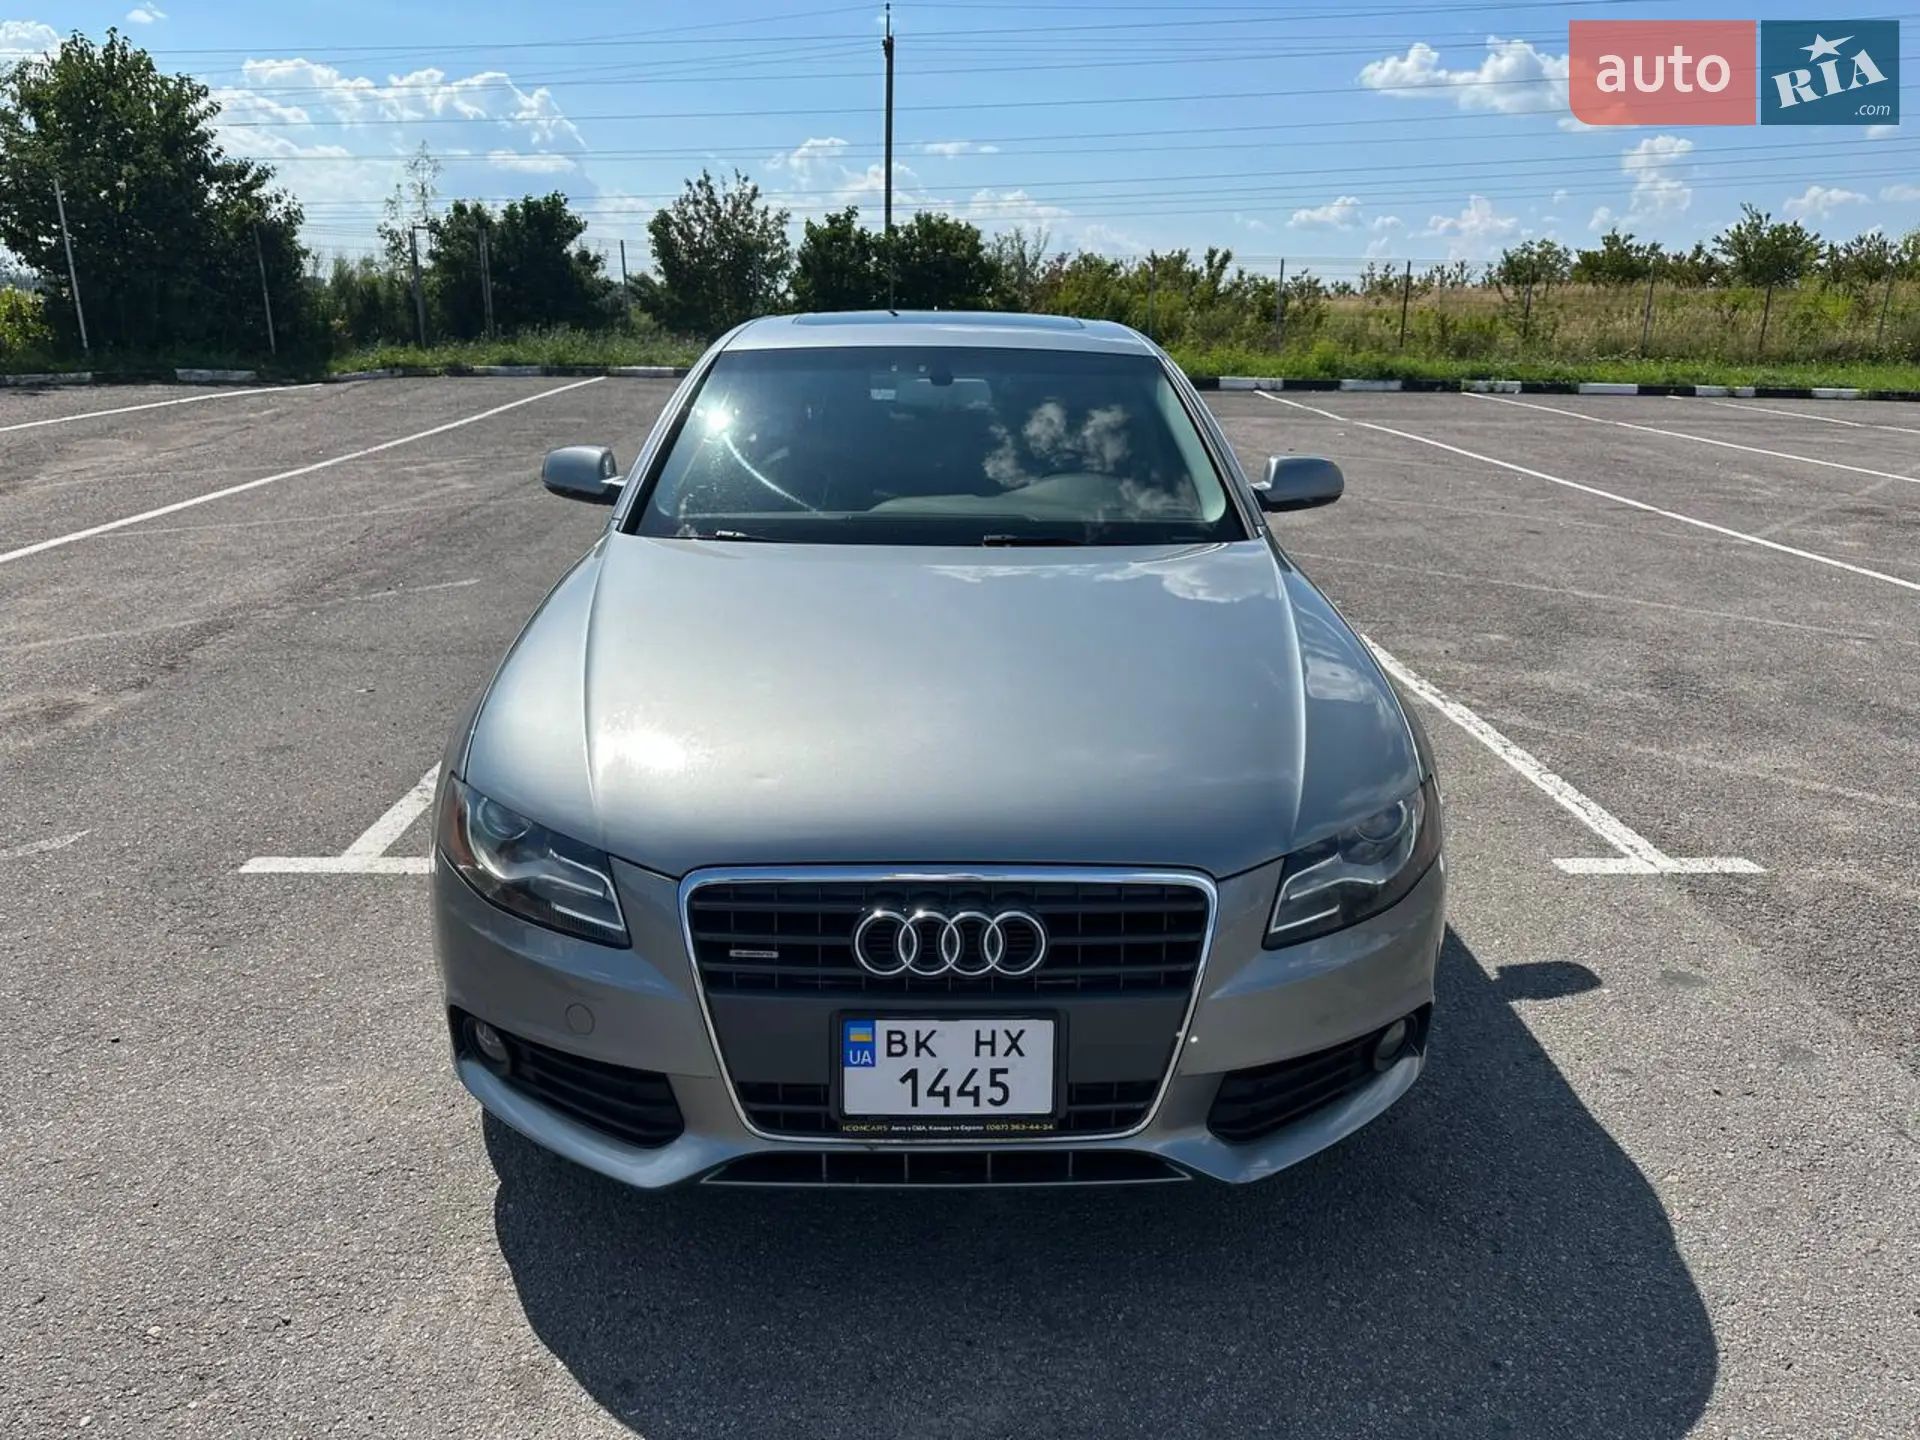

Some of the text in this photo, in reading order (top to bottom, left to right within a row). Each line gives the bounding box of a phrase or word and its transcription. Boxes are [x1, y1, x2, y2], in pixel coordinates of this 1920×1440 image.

[849, 1050, 873, 1064] UA
[886, 1029, 1025, 1058] BK HX
[899, 1068, 1010, 1108] 1445
